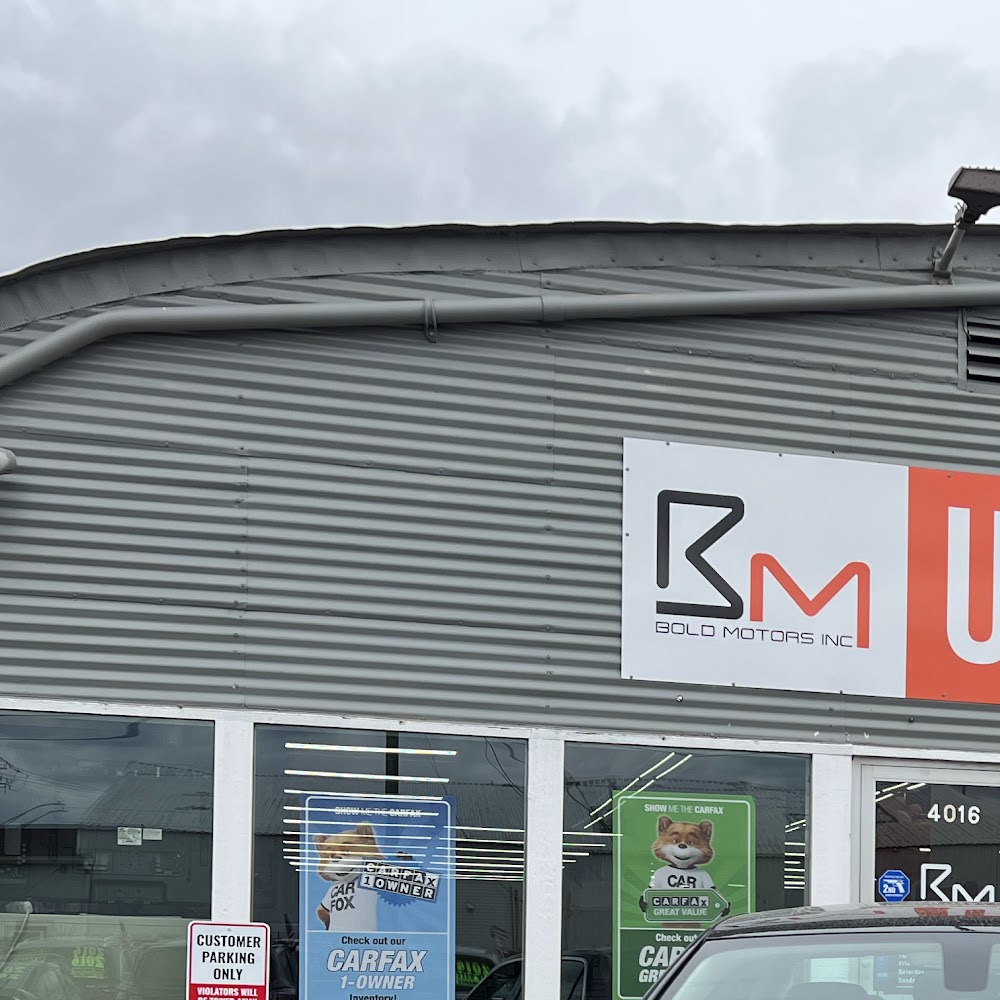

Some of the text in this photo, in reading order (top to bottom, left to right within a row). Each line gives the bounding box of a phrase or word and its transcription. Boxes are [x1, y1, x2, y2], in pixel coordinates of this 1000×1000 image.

[655, 621, 853, 648] BOLD MOTORS INC
[644, 804, 724, 814] SHOW ME THE CARFAX
[927, 804, 981, 824] 4016
[365, 862, 437, 887] CARFAX
[667, 874, 697, 889] CAR
[330, 881, 355, 898] CAR
[330, 895, 355, 913] FOX
[652, 896, 709, 907] CARFAX
[653, 908, 708, 916] GREAT VALUE
[197, 934, 261, 948] CUSTOMER
[341, 936, 370, 945] Check
[373, 937, 388, 945] out
[655, 932, 698, 942] Check out
[202, 951, 255, 965] PARKING
[327, 949, 428, 972] CARFAX
[638, 945, 686, 967] CAR
[213, 968, 243, 981] ONLY
[340, 975, 416, 990] 1-OWNER
[197, 987, 258, 997] VIOLATORS WILL
